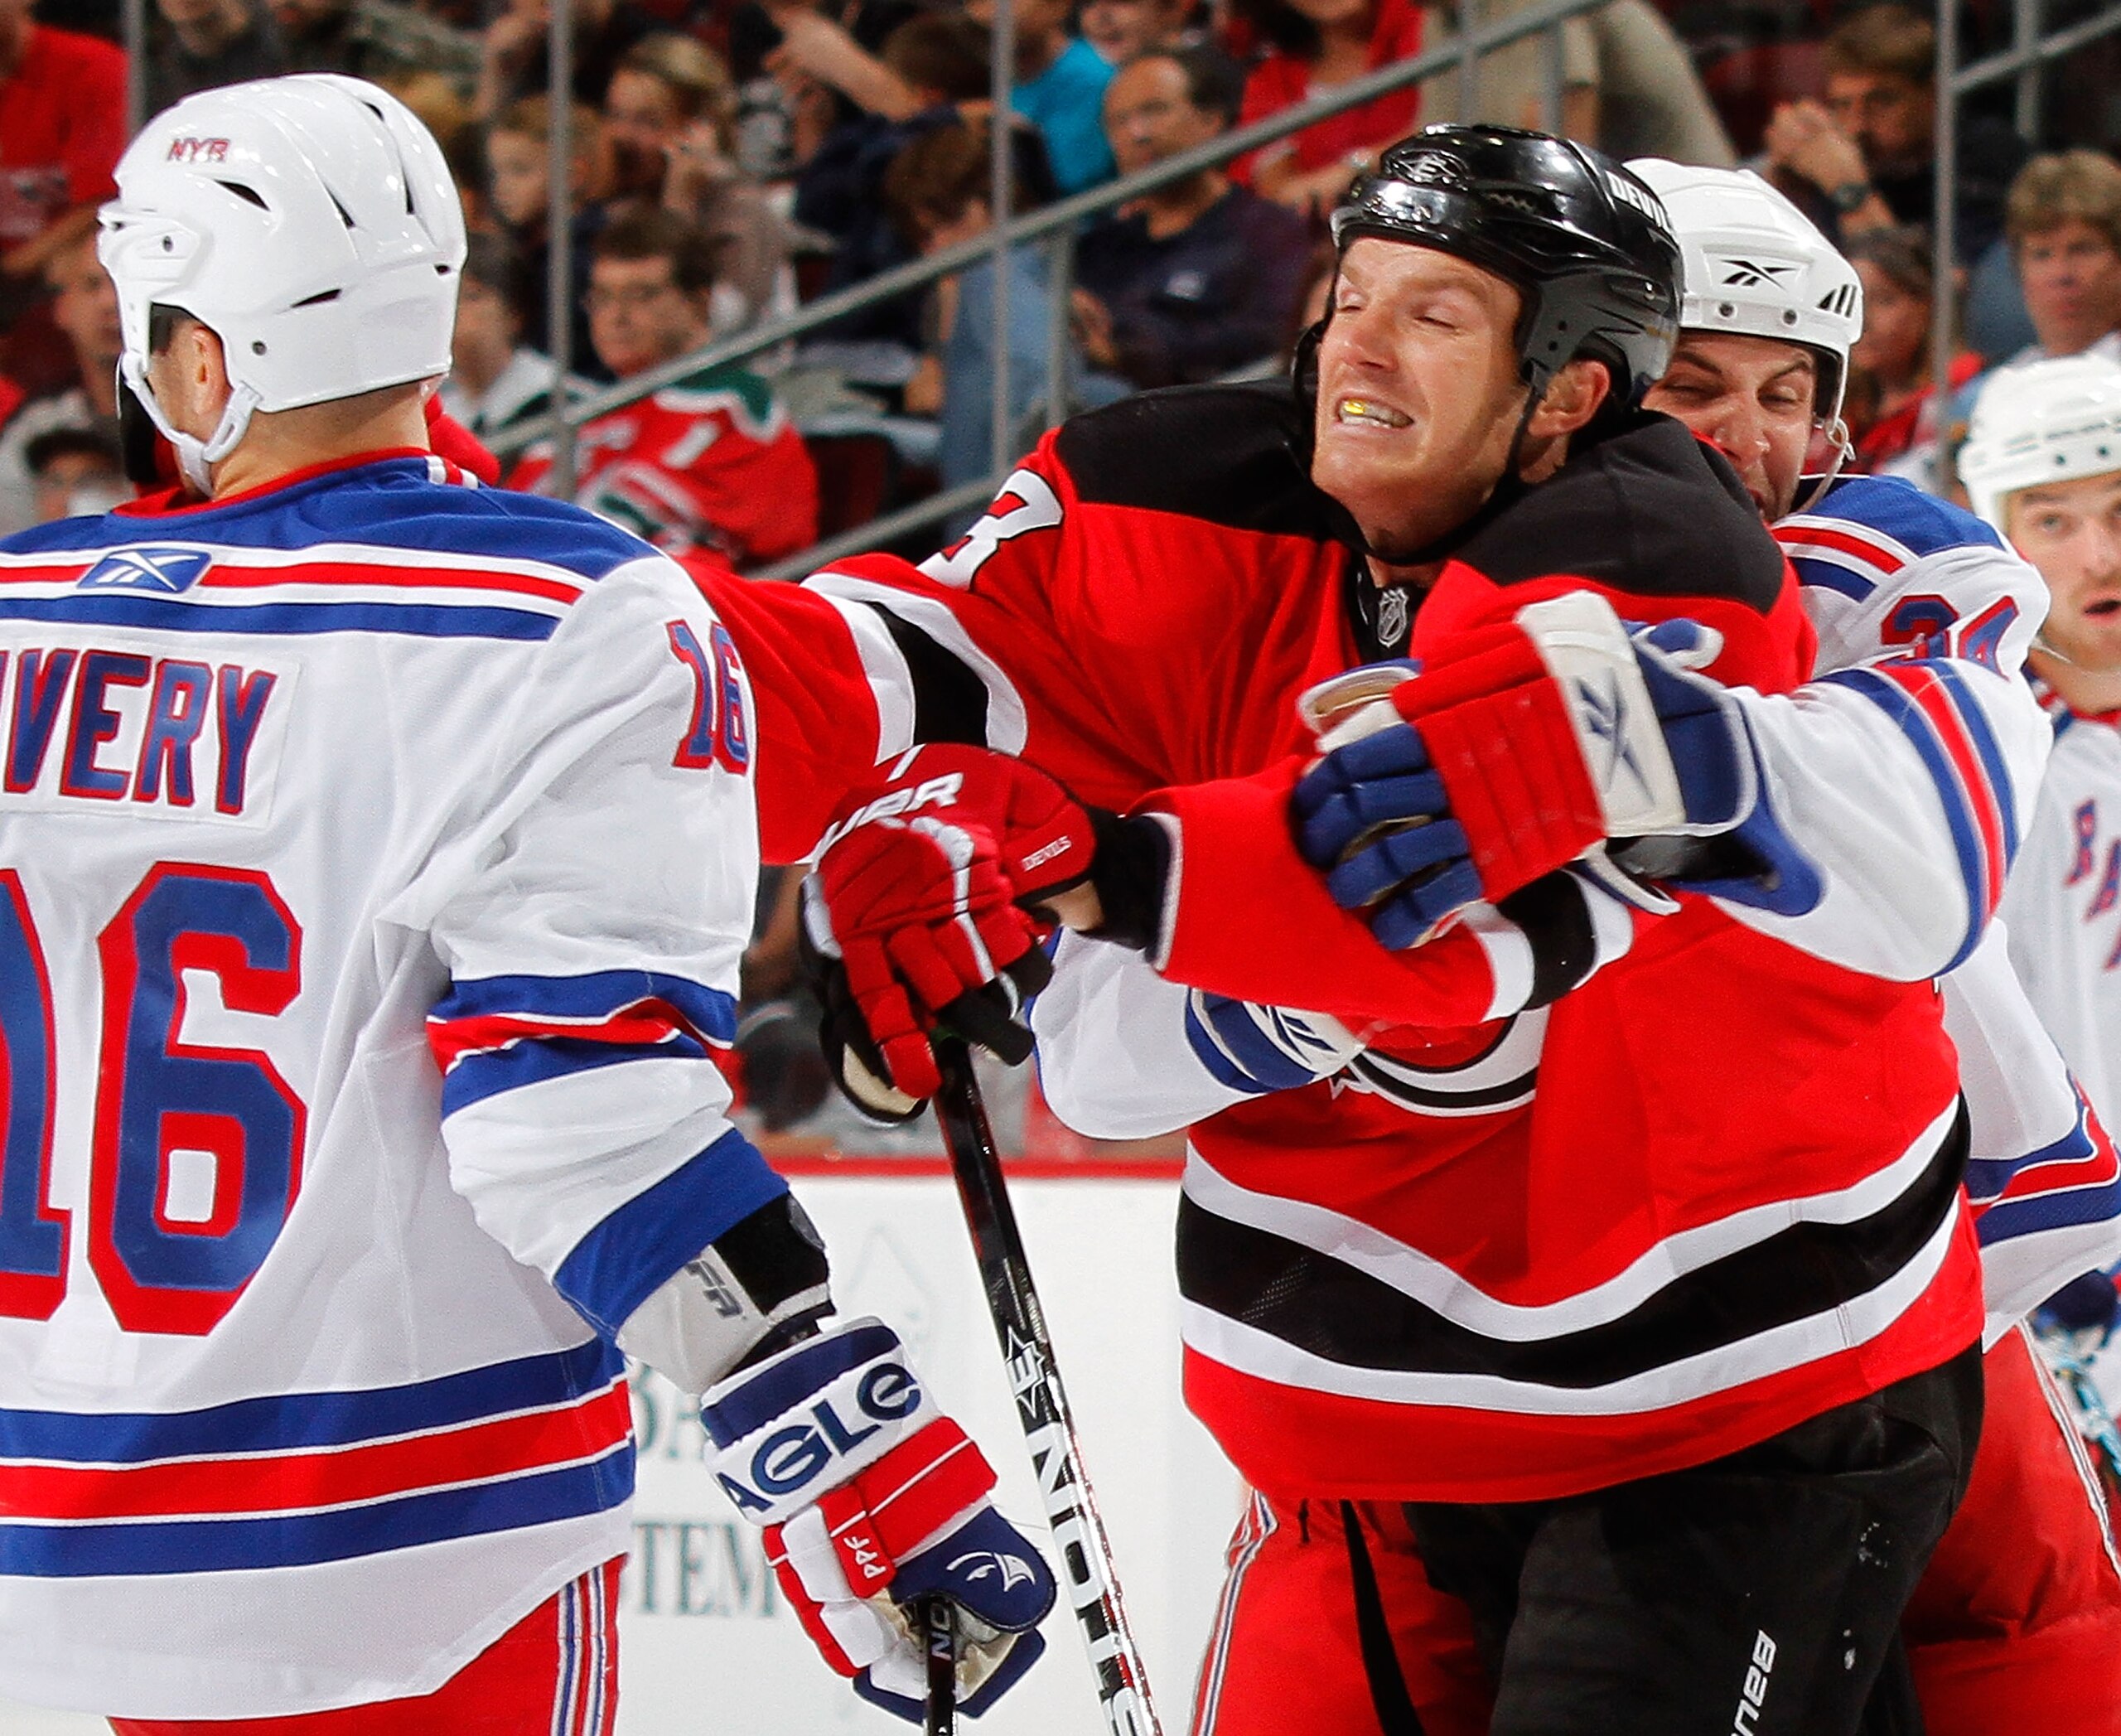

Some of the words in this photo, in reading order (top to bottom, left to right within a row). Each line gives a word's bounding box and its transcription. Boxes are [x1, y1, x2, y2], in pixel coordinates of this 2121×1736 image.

[167, 137, 230, 163] NYR
[0, 648, 278, 815] VERY
[665, 618, 750, 777] 16
[621, 1520, 777, 1617] TEM
[843, 1535, 887, 1579] PPF
[1730, 1629, 1777, 1736] BAU
